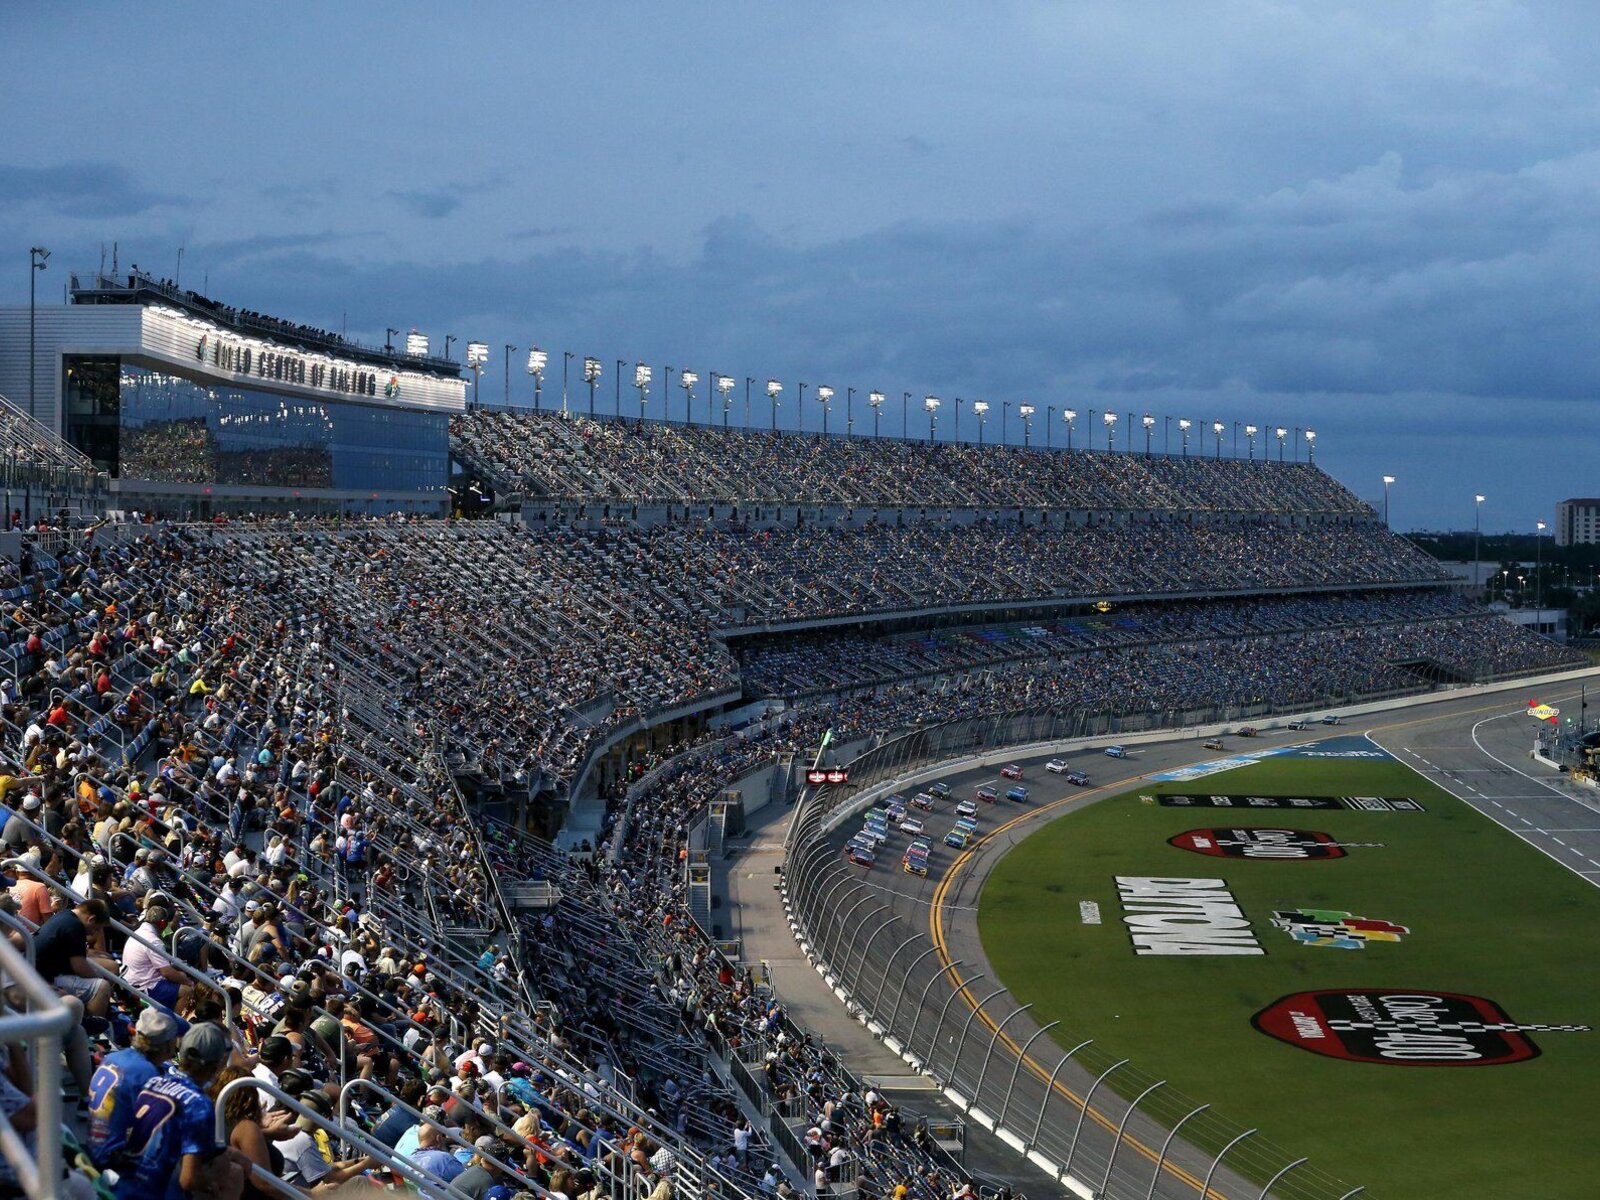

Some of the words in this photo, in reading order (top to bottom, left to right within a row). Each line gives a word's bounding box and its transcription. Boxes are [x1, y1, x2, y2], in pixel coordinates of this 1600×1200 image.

[1528, 708, 1559, 716] SUNOCO
[1115, 876, 1266, 956] DAYTONA
[1378, 995, 1450, 1021] Coke
[1373, 1032, 1482, 1060] 400
[89, 1065, 118, 1112] 9
